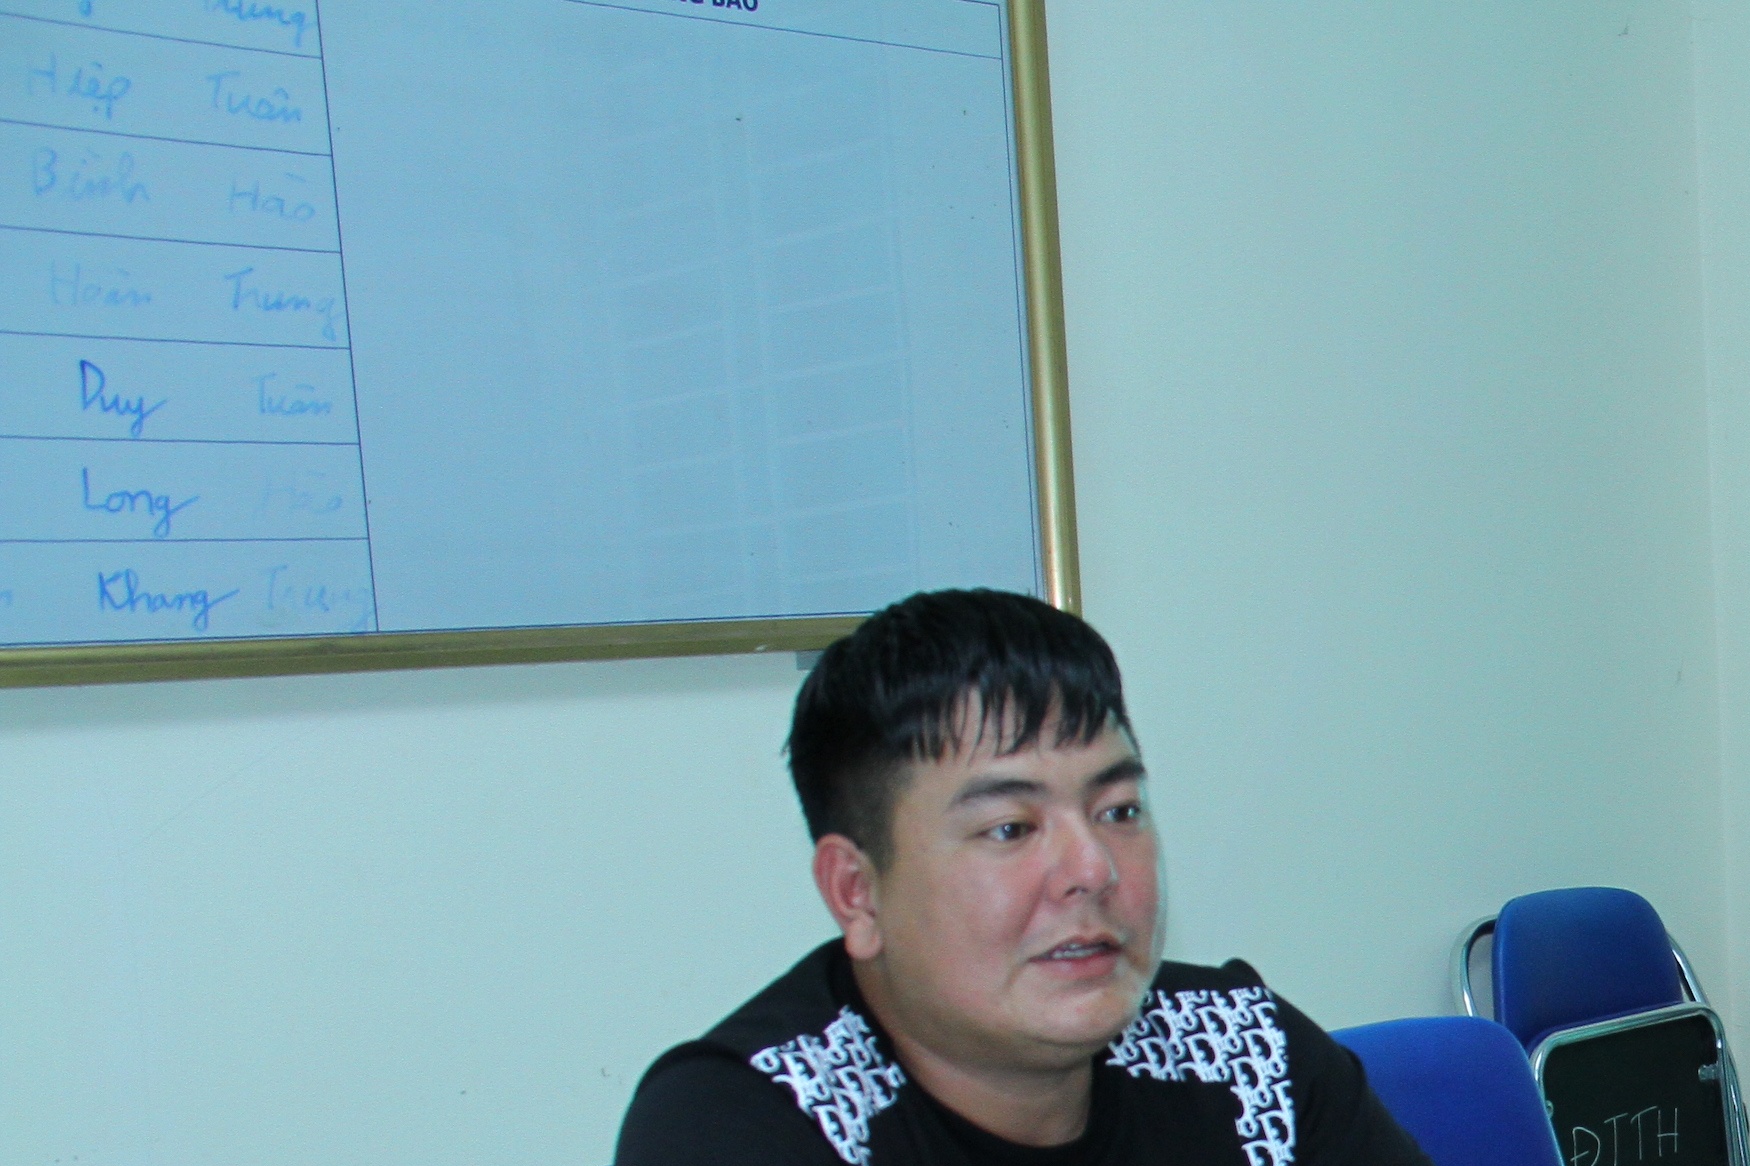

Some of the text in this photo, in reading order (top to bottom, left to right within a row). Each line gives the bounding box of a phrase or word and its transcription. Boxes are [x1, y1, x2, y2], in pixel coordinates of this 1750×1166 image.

[223, 266, 342, 341] Trung
[78, 358, 168, 438] Duy
[81, 466, 200, 538] Long
[97, 568, 240, 632] Khang
